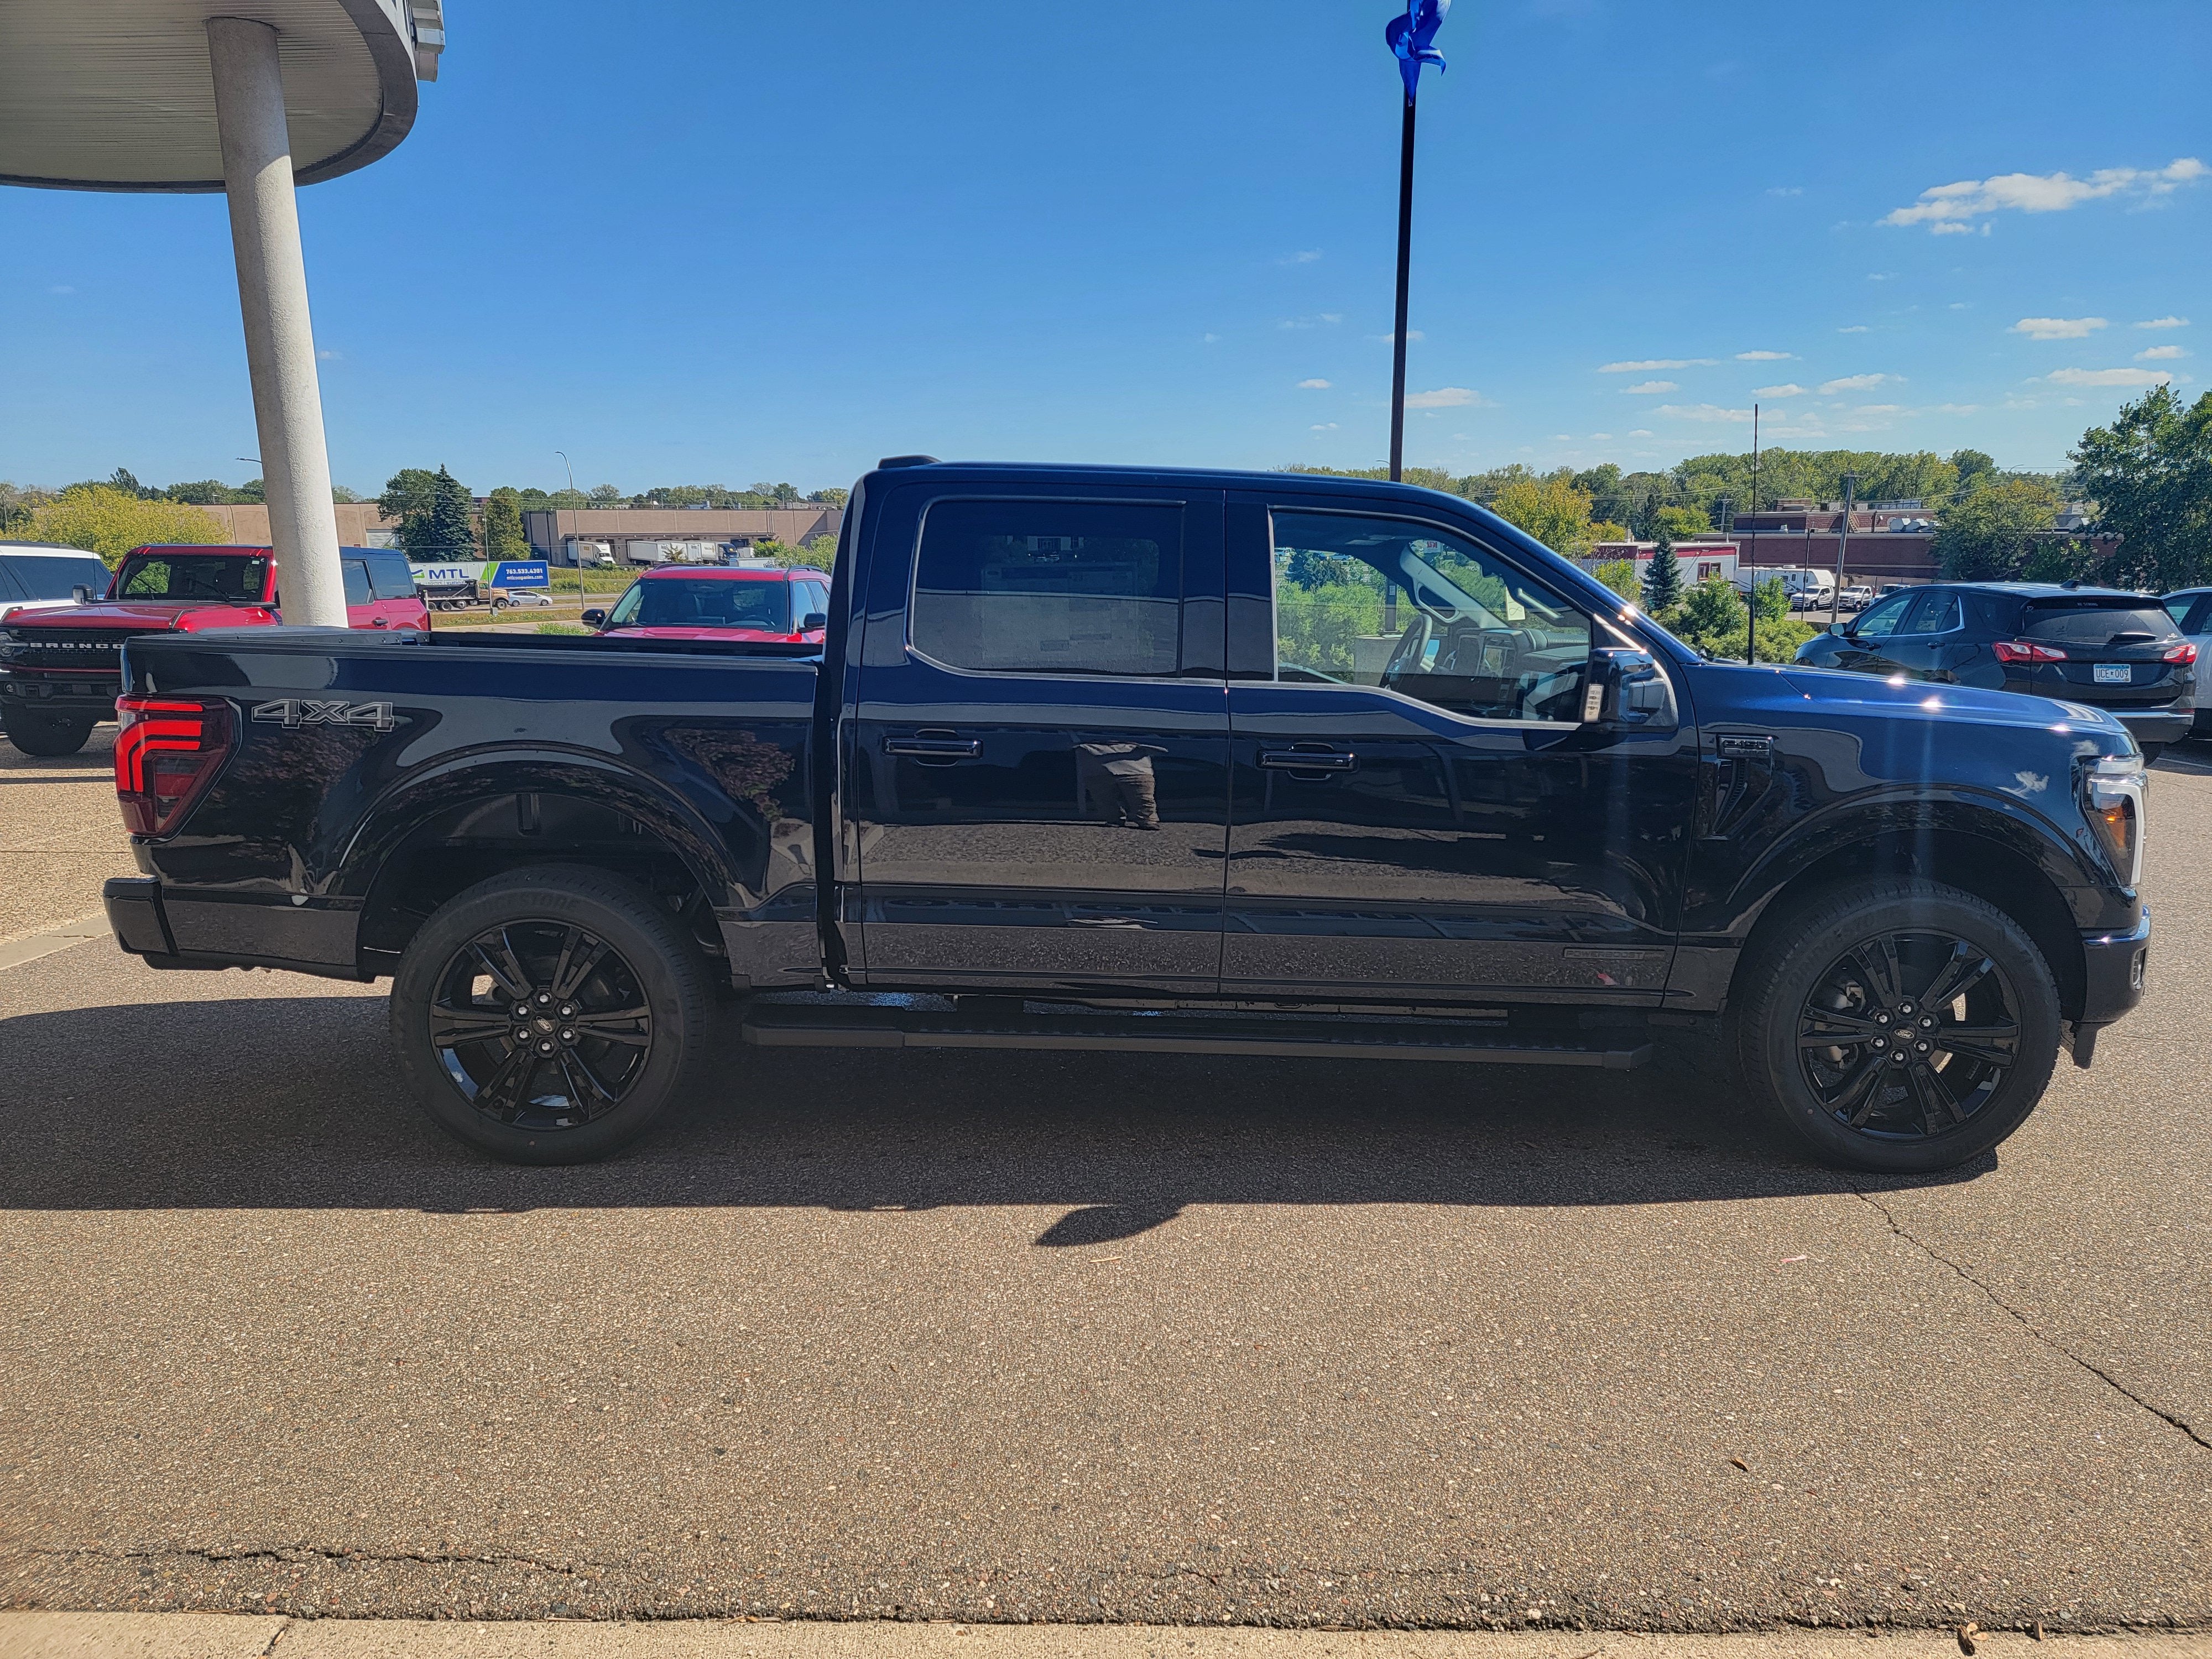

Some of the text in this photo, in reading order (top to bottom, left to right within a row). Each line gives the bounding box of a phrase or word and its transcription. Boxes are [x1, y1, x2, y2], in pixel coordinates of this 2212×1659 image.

[429, 569, 469, 580] MTL
[2096, 669, 2128, 678] UCE 009
[1566, 950, 1644, 959] POWERBOOST
